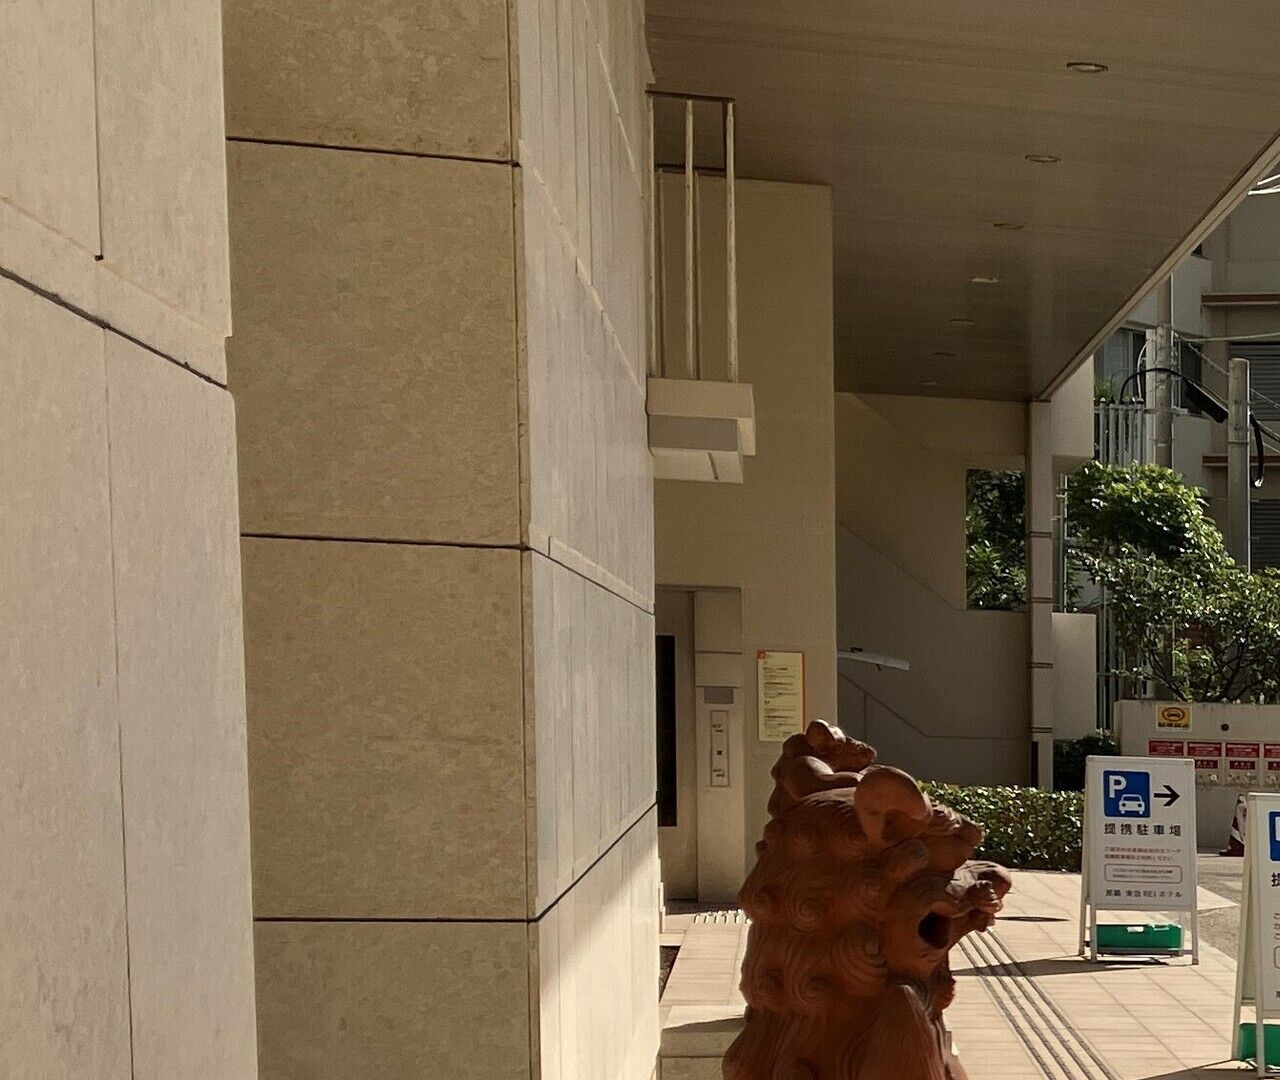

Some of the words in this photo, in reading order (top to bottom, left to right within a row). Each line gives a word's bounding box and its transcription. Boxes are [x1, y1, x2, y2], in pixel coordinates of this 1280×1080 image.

[1109, 775, 1127, 798] P
[1104, 823, 1181, 837] 提携駐車場
